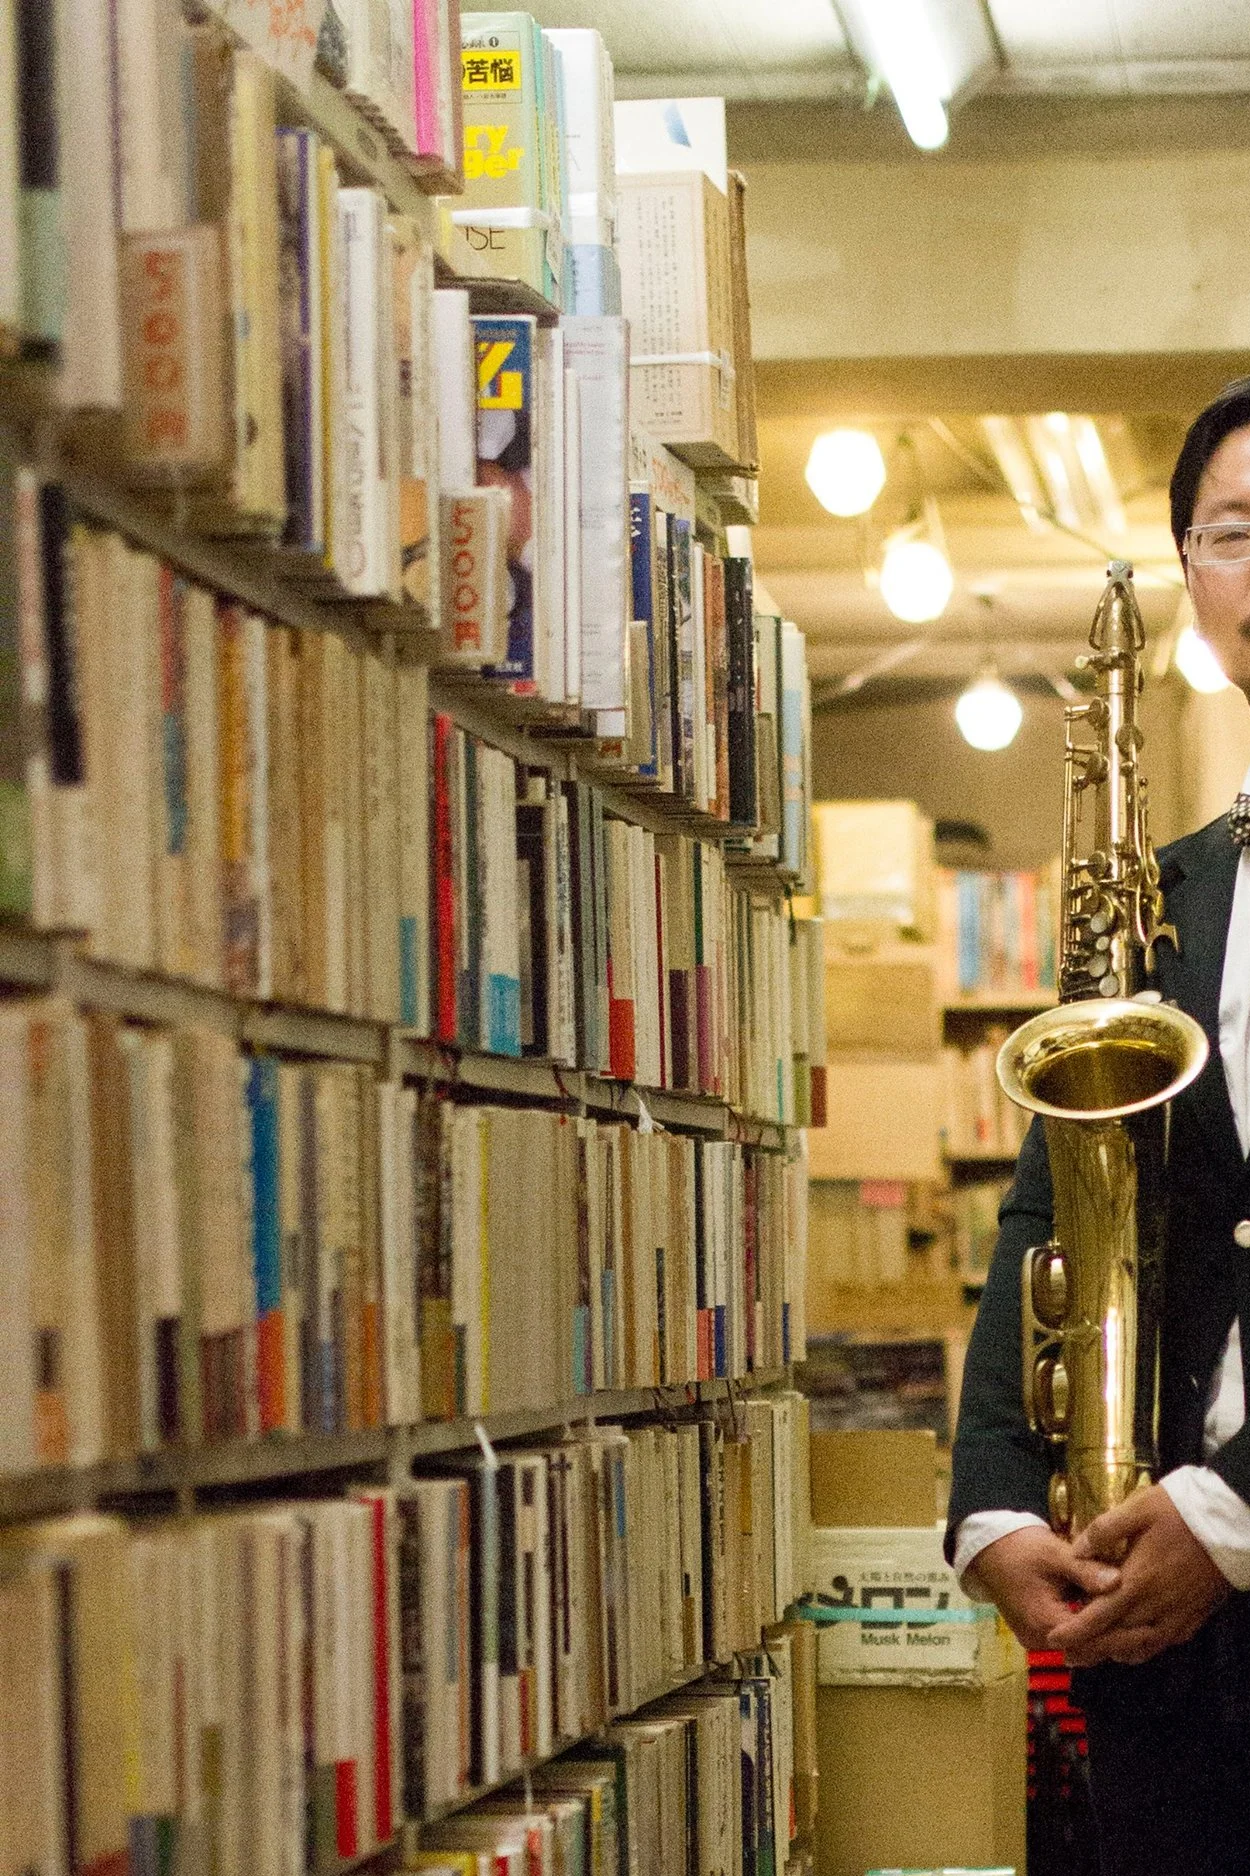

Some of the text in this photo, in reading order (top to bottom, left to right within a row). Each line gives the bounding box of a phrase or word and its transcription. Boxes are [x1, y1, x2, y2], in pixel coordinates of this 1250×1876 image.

[461, 58, 514, 83] 苦悩
[861, 1633, 951, 1647] Musk Melon
